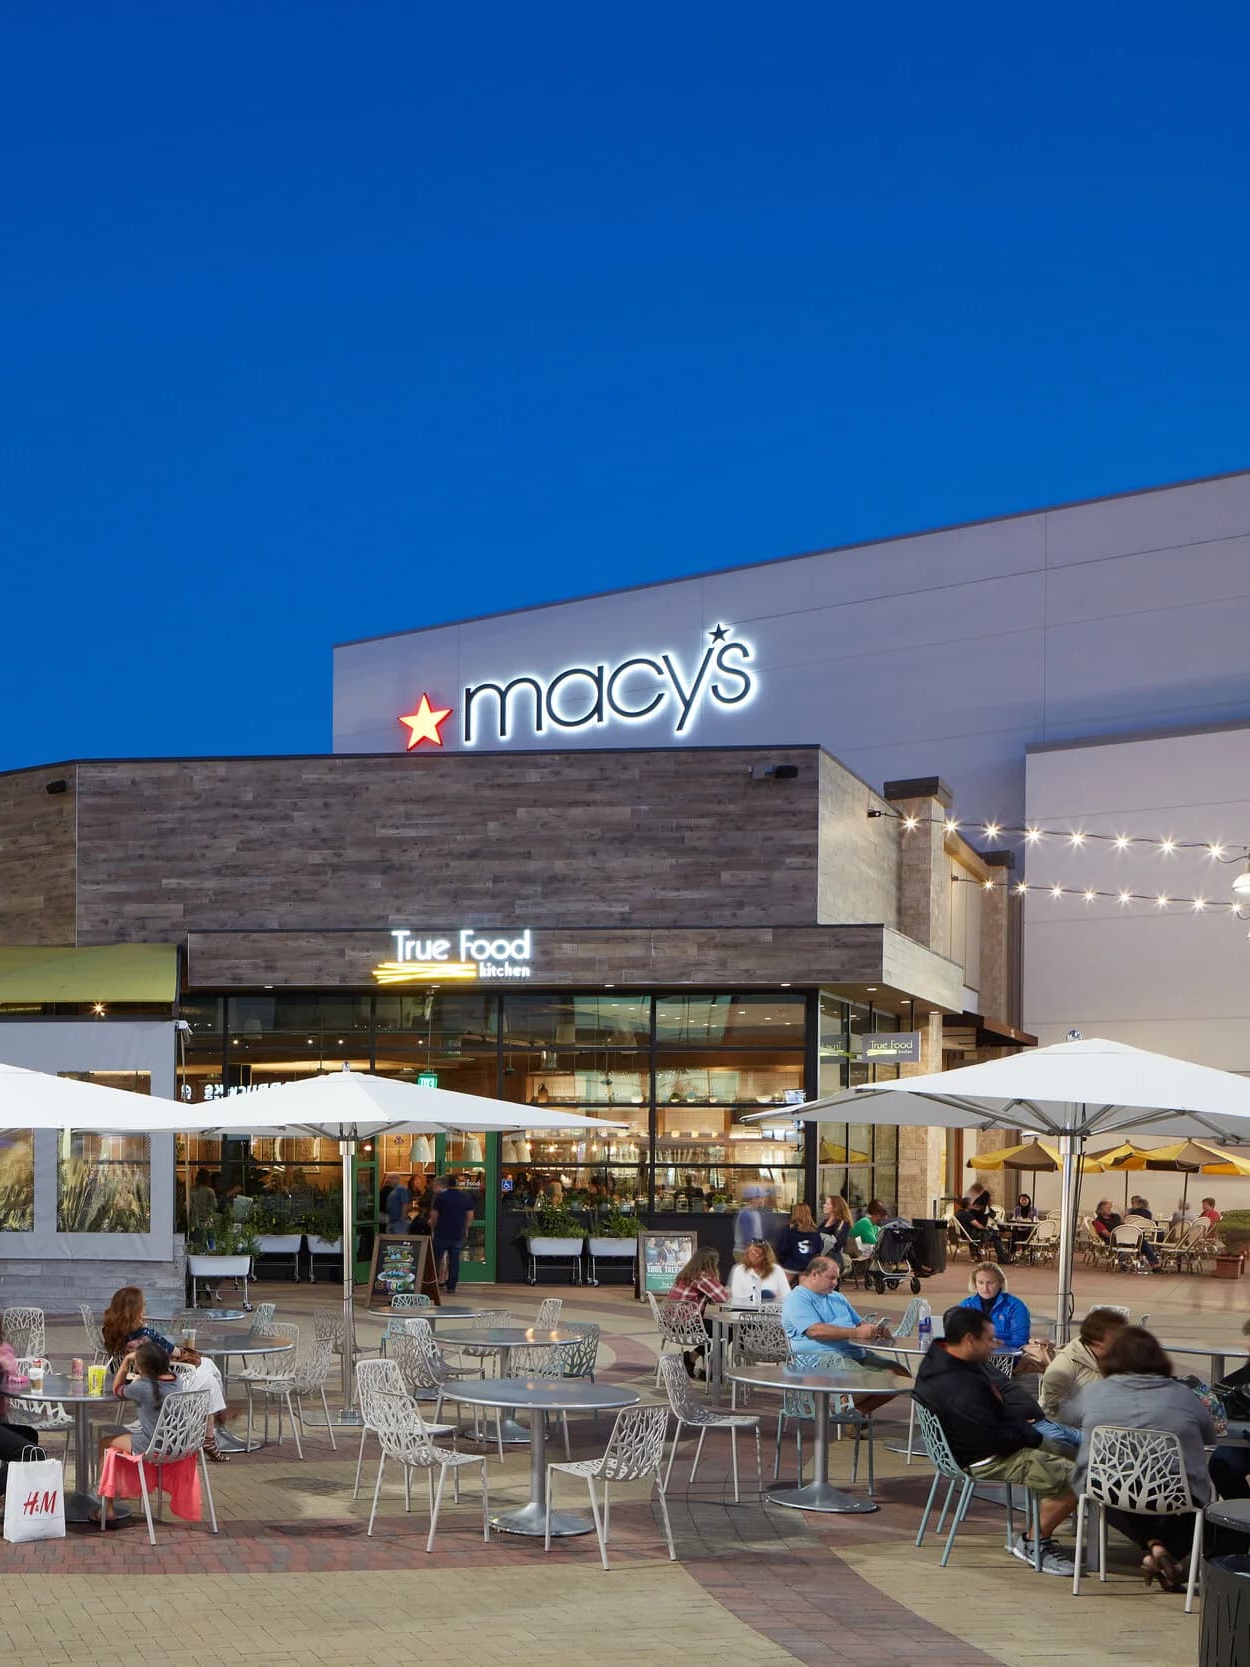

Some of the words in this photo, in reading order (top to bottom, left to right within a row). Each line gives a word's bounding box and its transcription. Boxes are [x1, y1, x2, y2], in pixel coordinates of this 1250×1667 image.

[391, 929, 451, 962] True
[460, 929, 530, 962] Food
[479, 962, 531, 978] kitchen
[870, 1040, 888, 1050] True
[890, 1040, 913, 1050] Food
[23, 1490, 58, 1515] H&M
